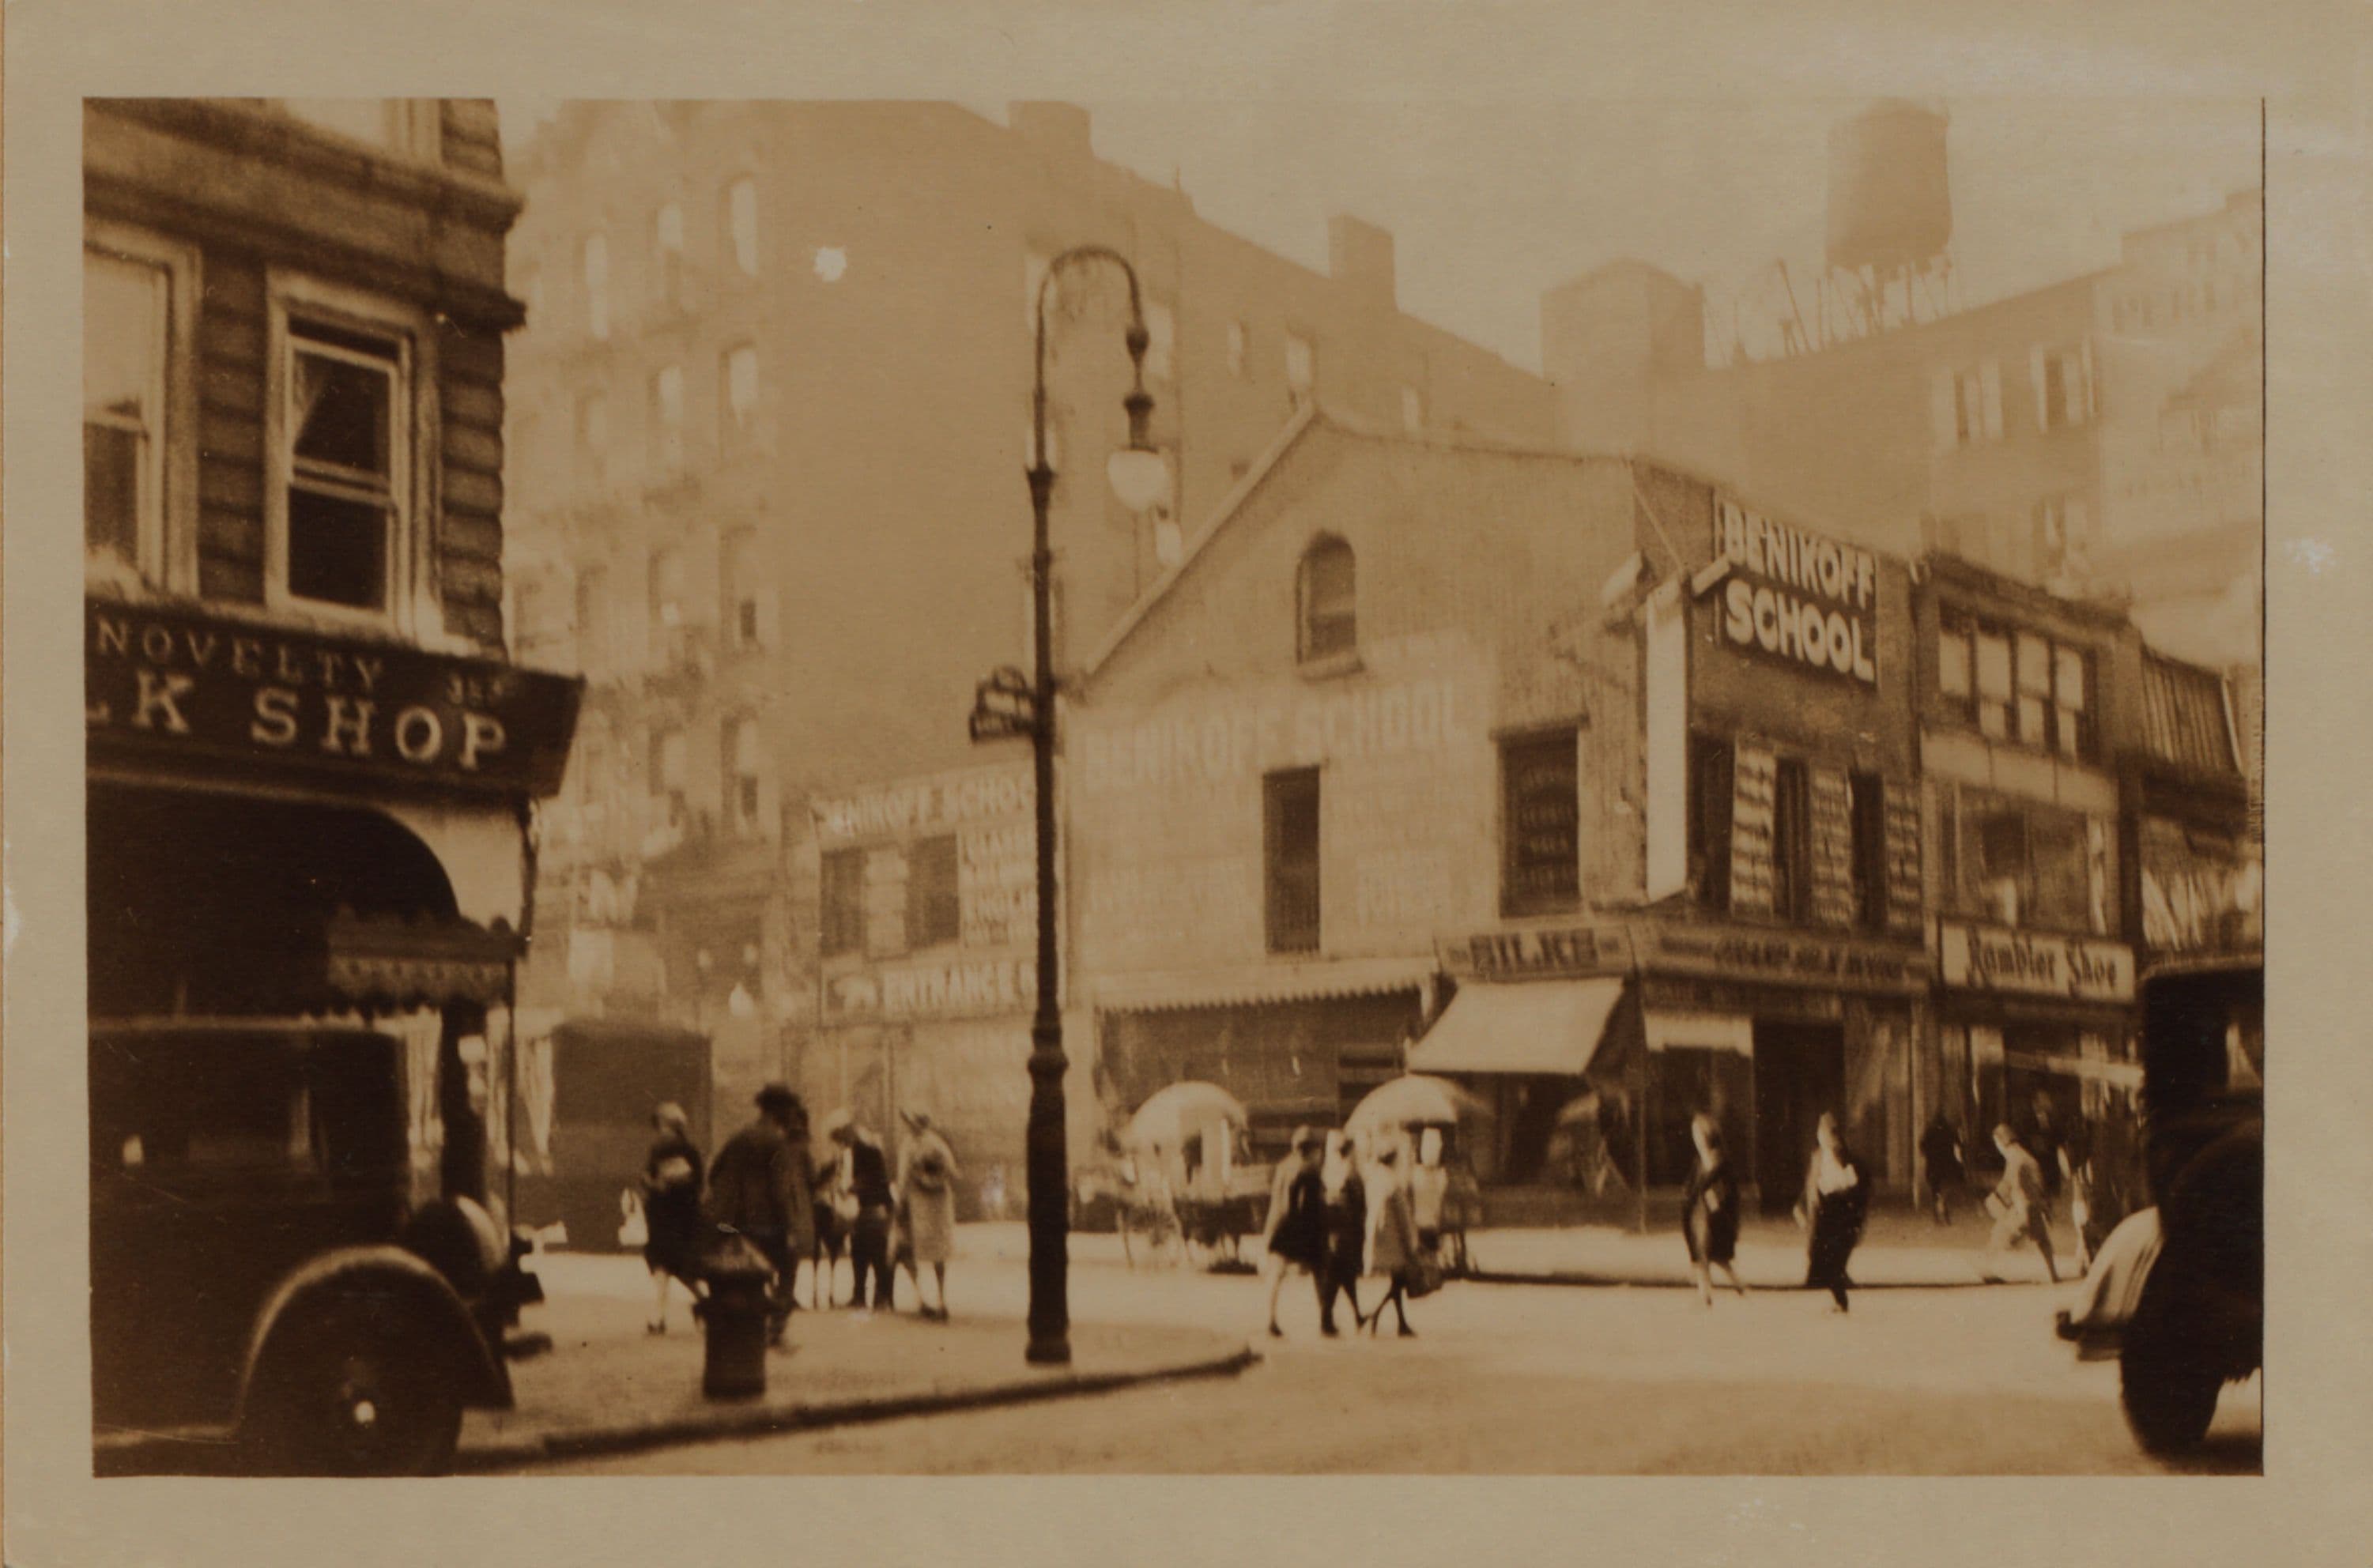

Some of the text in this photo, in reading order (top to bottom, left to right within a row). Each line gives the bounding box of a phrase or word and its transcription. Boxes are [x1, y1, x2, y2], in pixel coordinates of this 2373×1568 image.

[1724, 502, 1876, 610] BENIKOFF
[96, 614, 383, 692] NOVELTY
[1726, 579, 1875, 683] SCHOOL
[250, 685, 507, 771] SHOP
